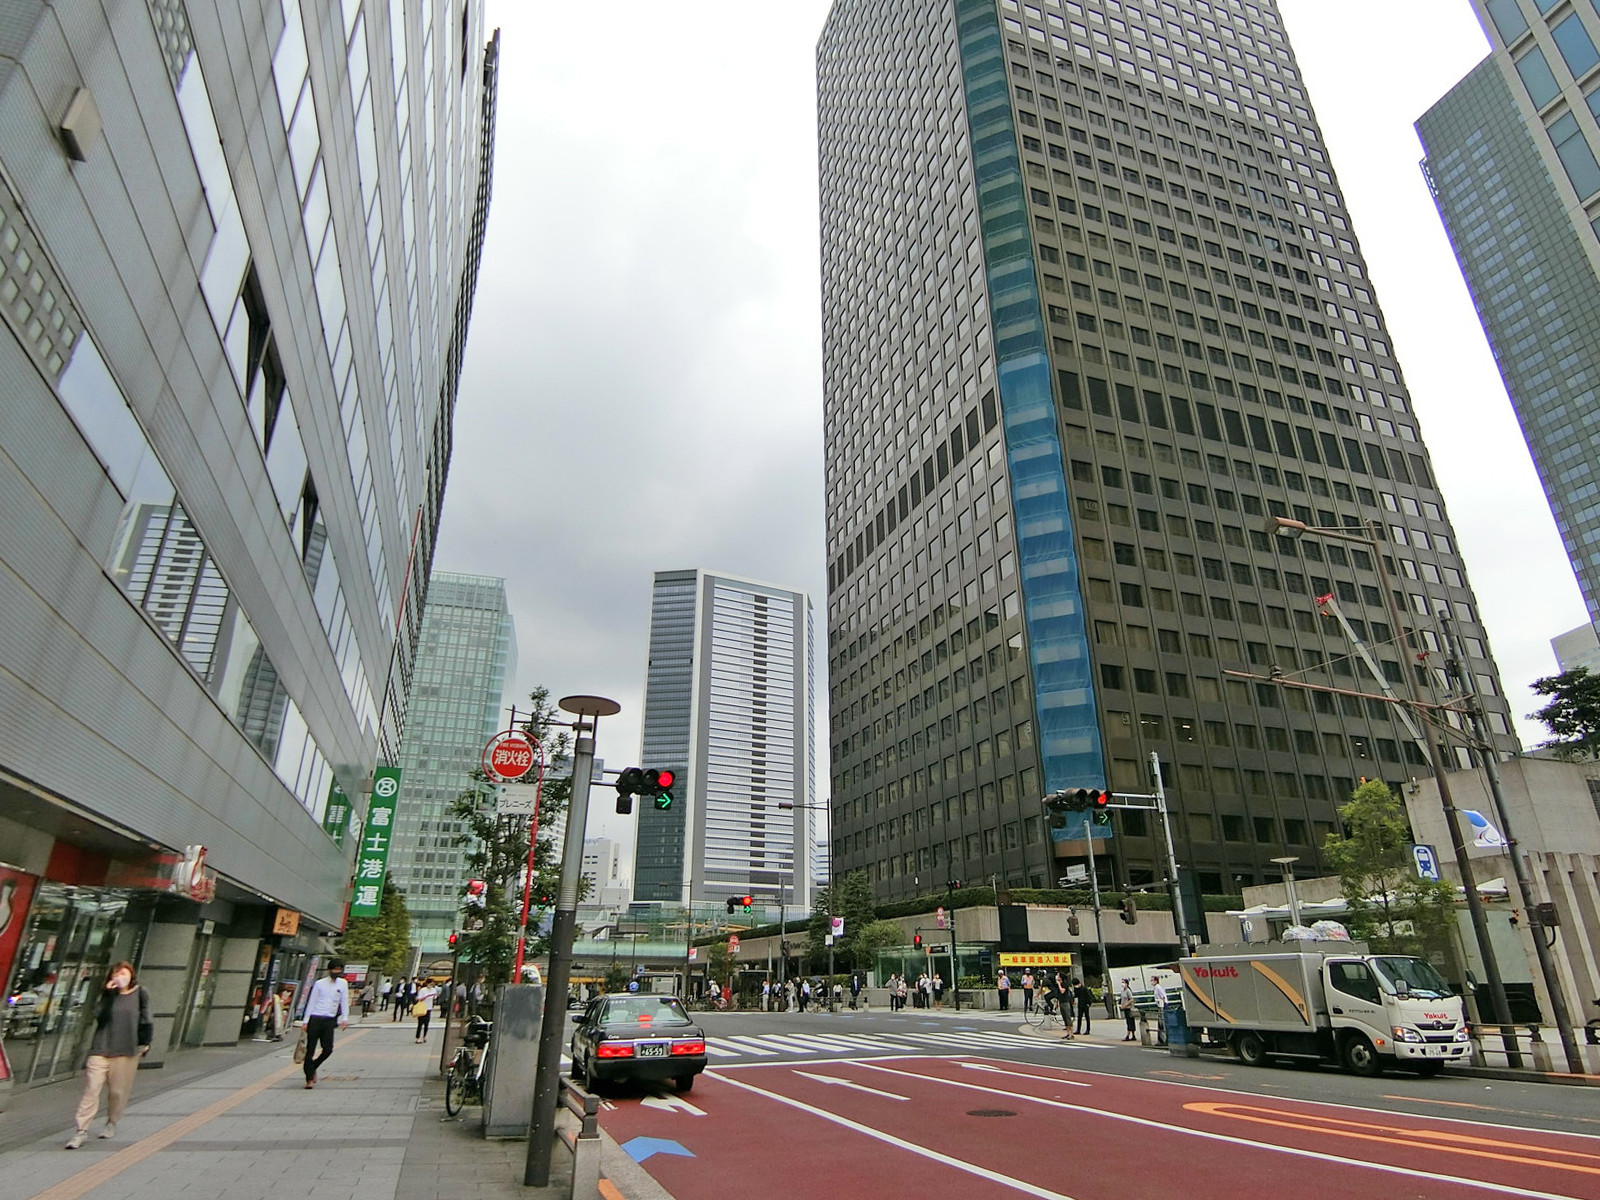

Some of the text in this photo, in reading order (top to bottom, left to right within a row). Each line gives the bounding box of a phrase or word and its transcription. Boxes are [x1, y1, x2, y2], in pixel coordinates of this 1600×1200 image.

[494, 749, 531, 767] 消火栓
[354, 806, 393, 906] 富士港運
[1193, 965, 1239, 978] Yakult
[1423, 1012, 1448, 1020] Yakult
